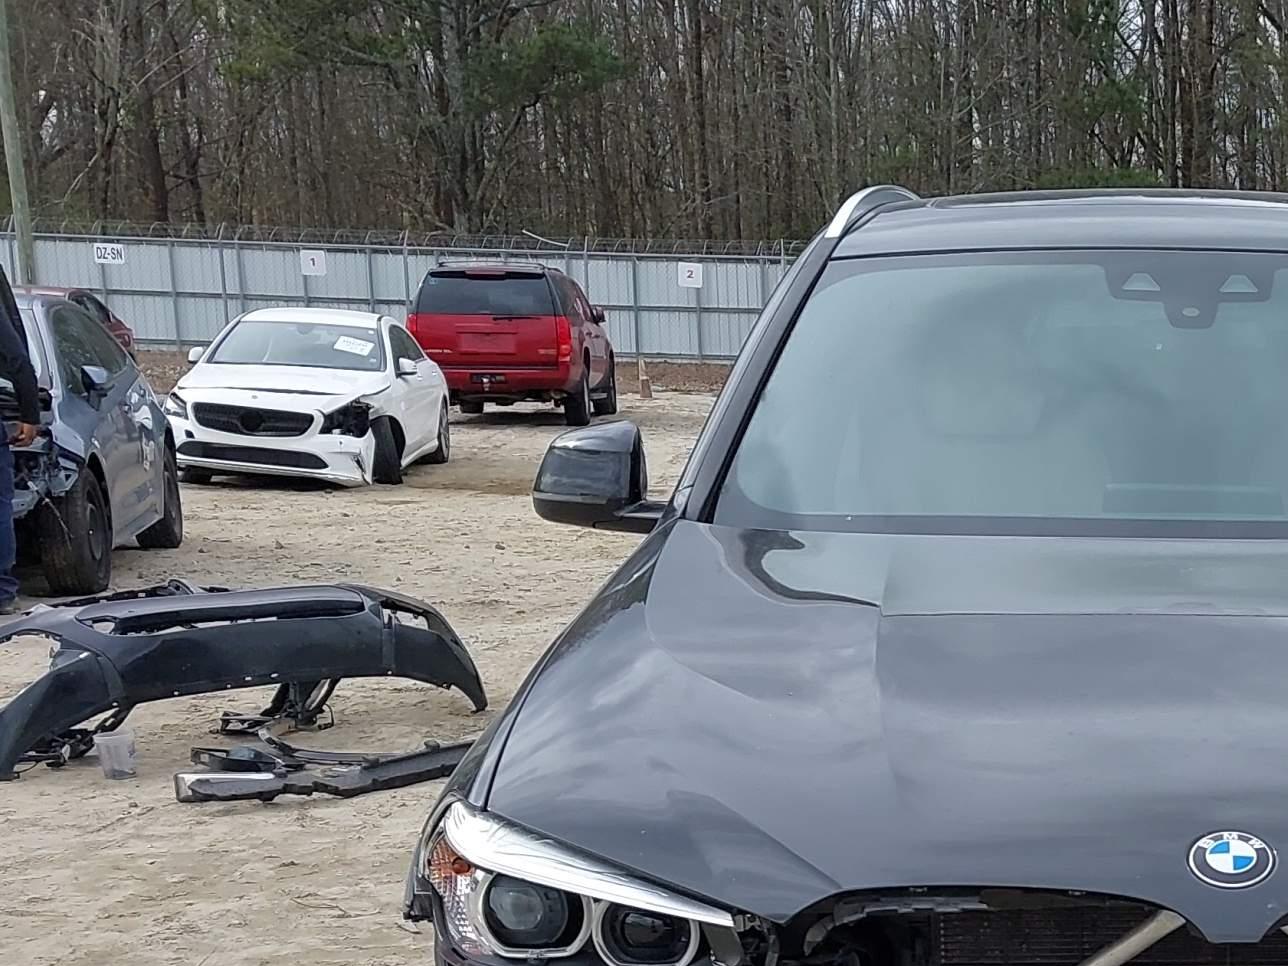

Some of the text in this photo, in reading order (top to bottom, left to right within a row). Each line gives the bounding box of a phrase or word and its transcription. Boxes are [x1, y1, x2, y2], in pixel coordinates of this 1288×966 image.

[96, 246, 123, 261] DZ-SN
[309, 257, 316, 267] 1
[686, 269, 694, 279] 2
